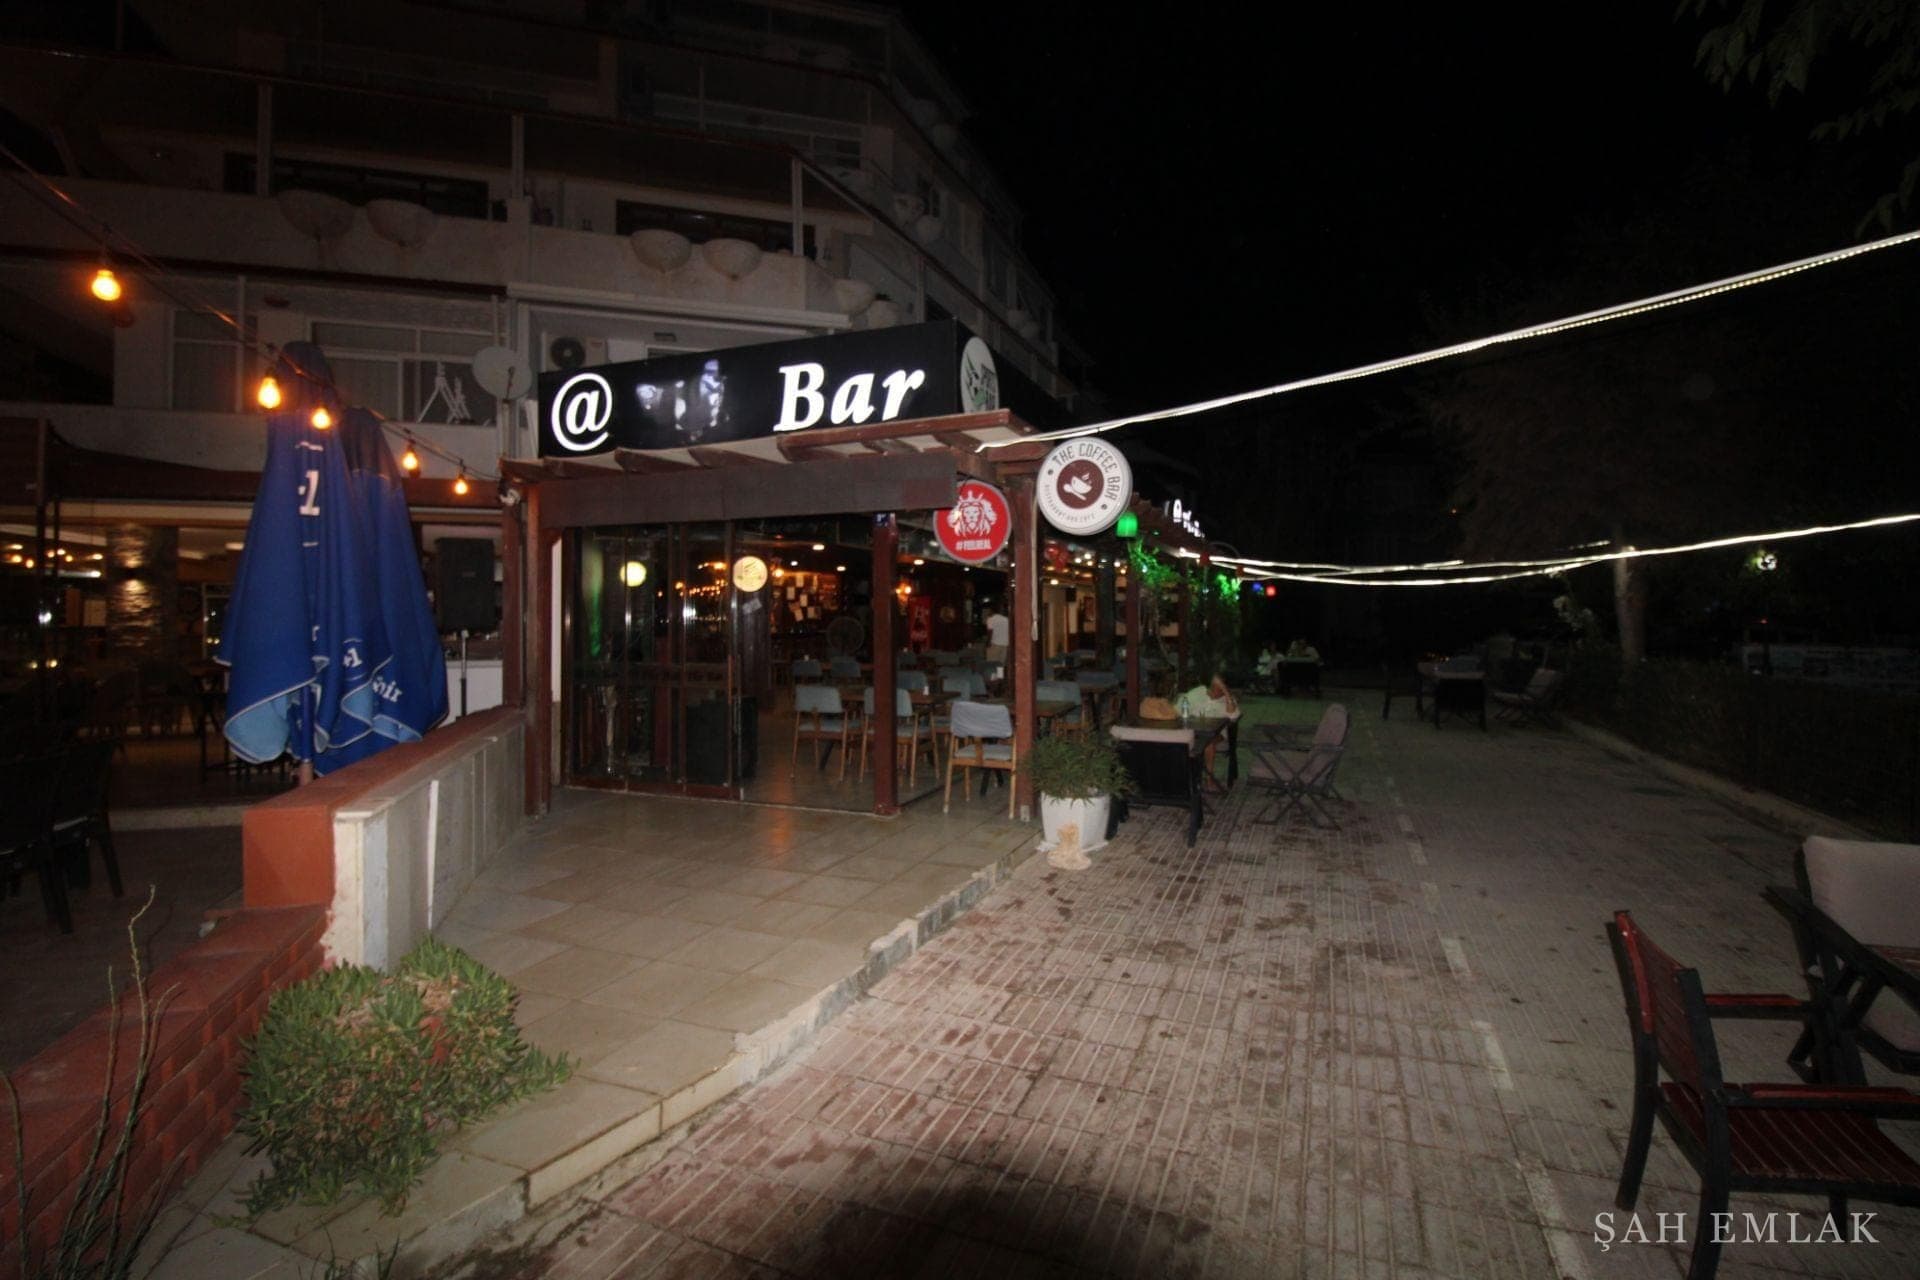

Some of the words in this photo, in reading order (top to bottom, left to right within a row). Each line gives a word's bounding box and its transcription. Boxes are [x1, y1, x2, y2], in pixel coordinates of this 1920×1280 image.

[551, 372, 613, 452] @
[773, 362, 926, 432] Bar
[1051, 445, 1076, 467] THE
[1078, 443, 1118, 473] COFFEE
[1104, 475, 1121, 501] BAR
